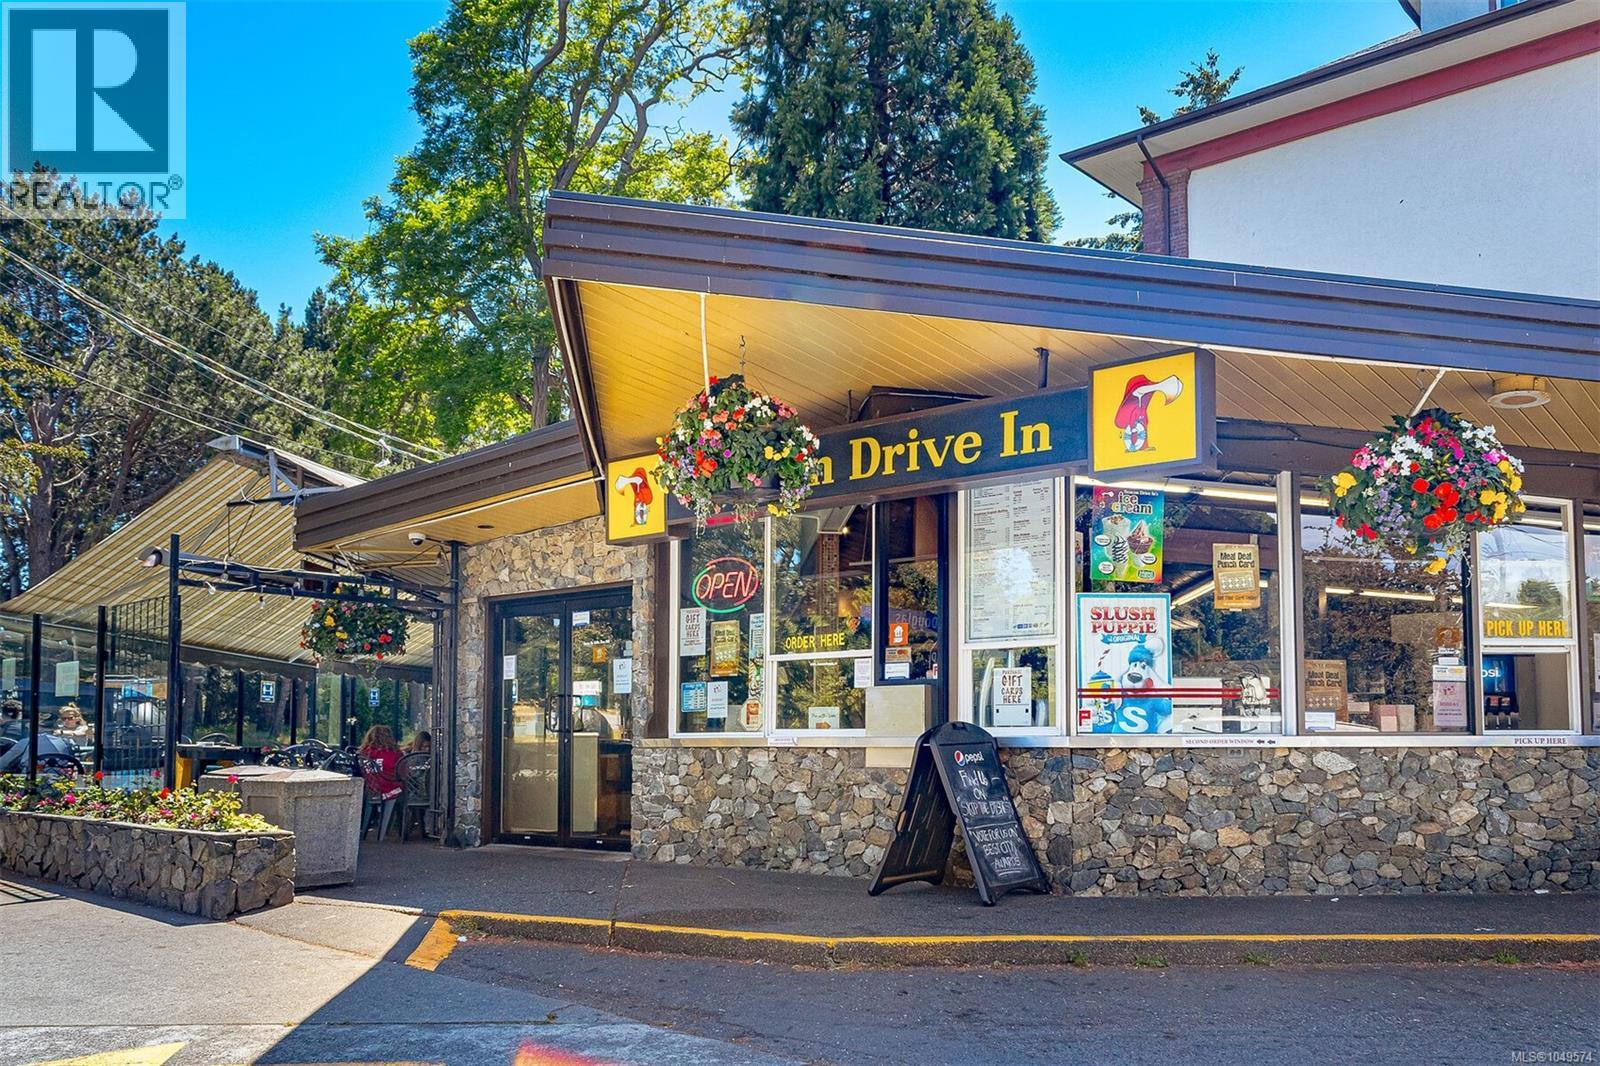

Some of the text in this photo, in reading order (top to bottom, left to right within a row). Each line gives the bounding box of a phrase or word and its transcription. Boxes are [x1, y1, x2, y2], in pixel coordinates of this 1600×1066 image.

[849, 428, 982, 480] Drive
[1000, 410, 1052, 458] In
[1119, 491, 1138, 504] ice
[1111, 502, 1153, 514] cream
[1238, 560, 1255, 568] Card
[696, 571, 753, 599] OPEN
[1090, 606, 1156, 620] SLUSH
[1486, 620, 1568, 637] PICK UP HERE
[785, 633, 845, 649] ORDER HERE
[1001, 675, 1023, 687] GIFT
[1001, 687, 1023, 696] CARDS
[1003, 695, 1021, 704] HERE
[1119, 706, 1149, 733] S
[964, 752, 984, 764] pepsi
